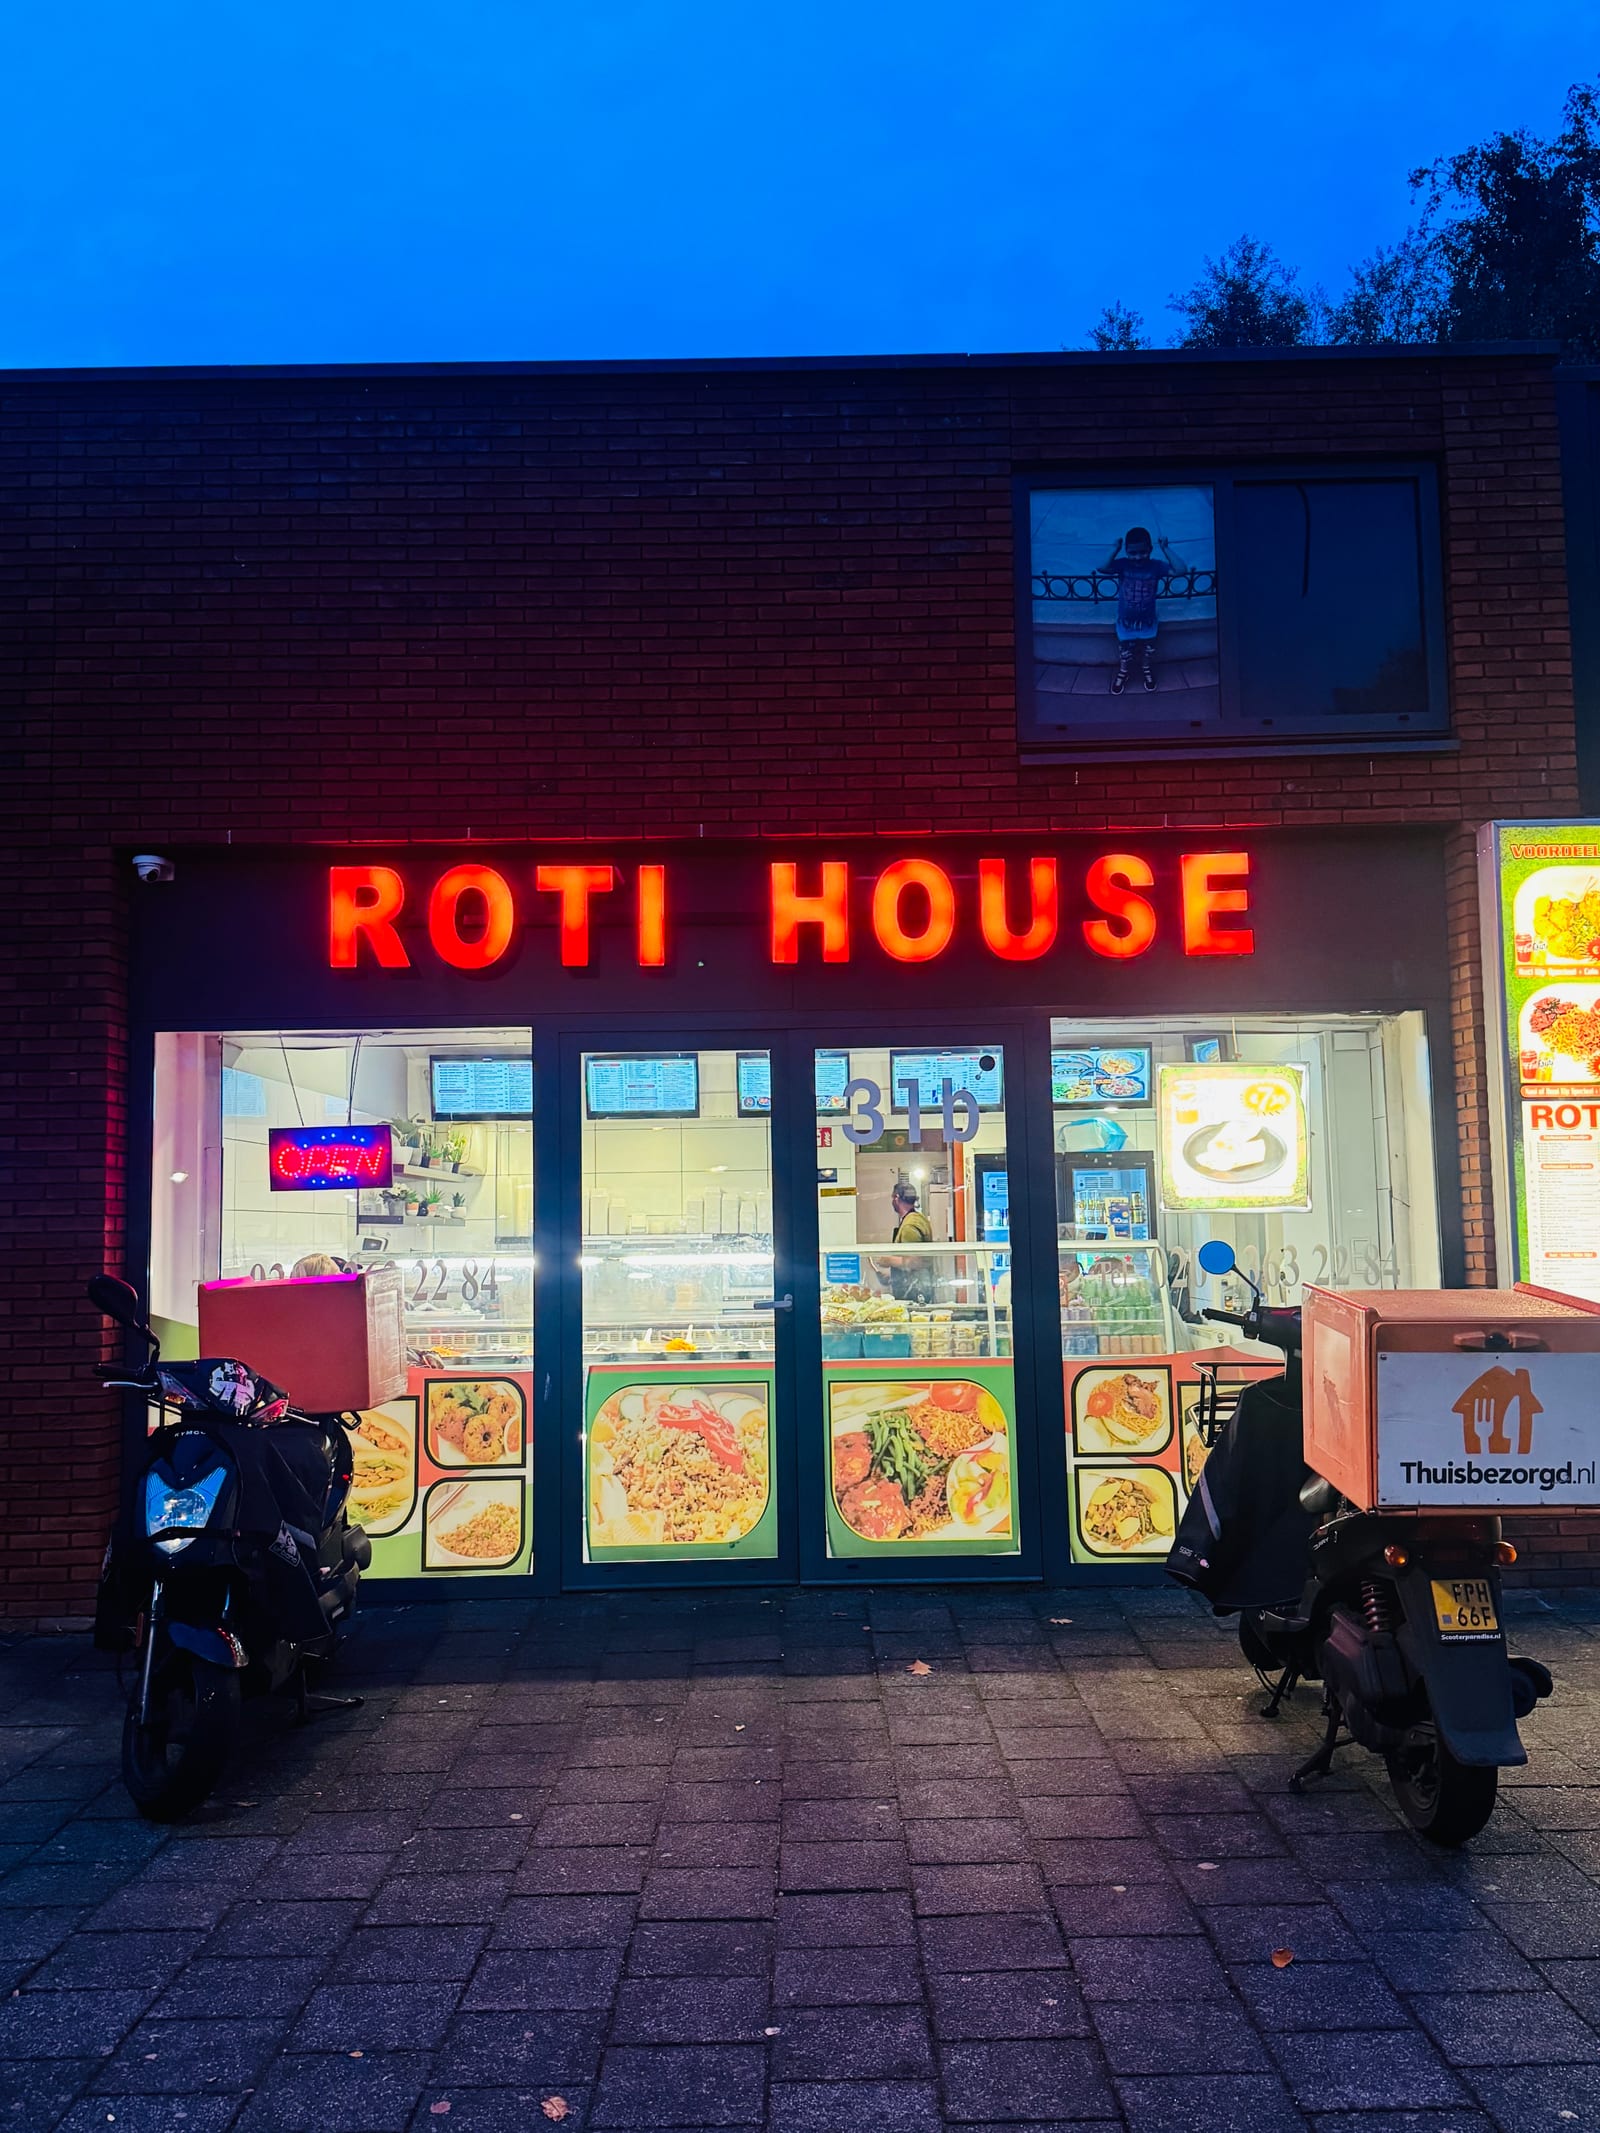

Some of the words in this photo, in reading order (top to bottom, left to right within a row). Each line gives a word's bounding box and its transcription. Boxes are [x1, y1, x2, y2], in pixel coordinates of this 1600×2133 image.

[330, 864, 665, 969] ROTI
[771, 852, 1255, 963] HOUSE
[842, 1078, 980, 1146] 31b
[1530, 1104, 1600, 1129] ROT
[278, 1146, 382, 1177] OPEN
[411, 1259, 448, 1300] 22
[461, 1257, 498, 1300] 84
[1312, 1243, 1350, 1285] 22
[1363, 1242, 1401, 1287] 84
[1400, 1461, 1596, 1491] Thuisbezorgd.nl
[1452, 1583, 1488, 1603] FPH
[1457, 1606, 1492, 1627] 66F
